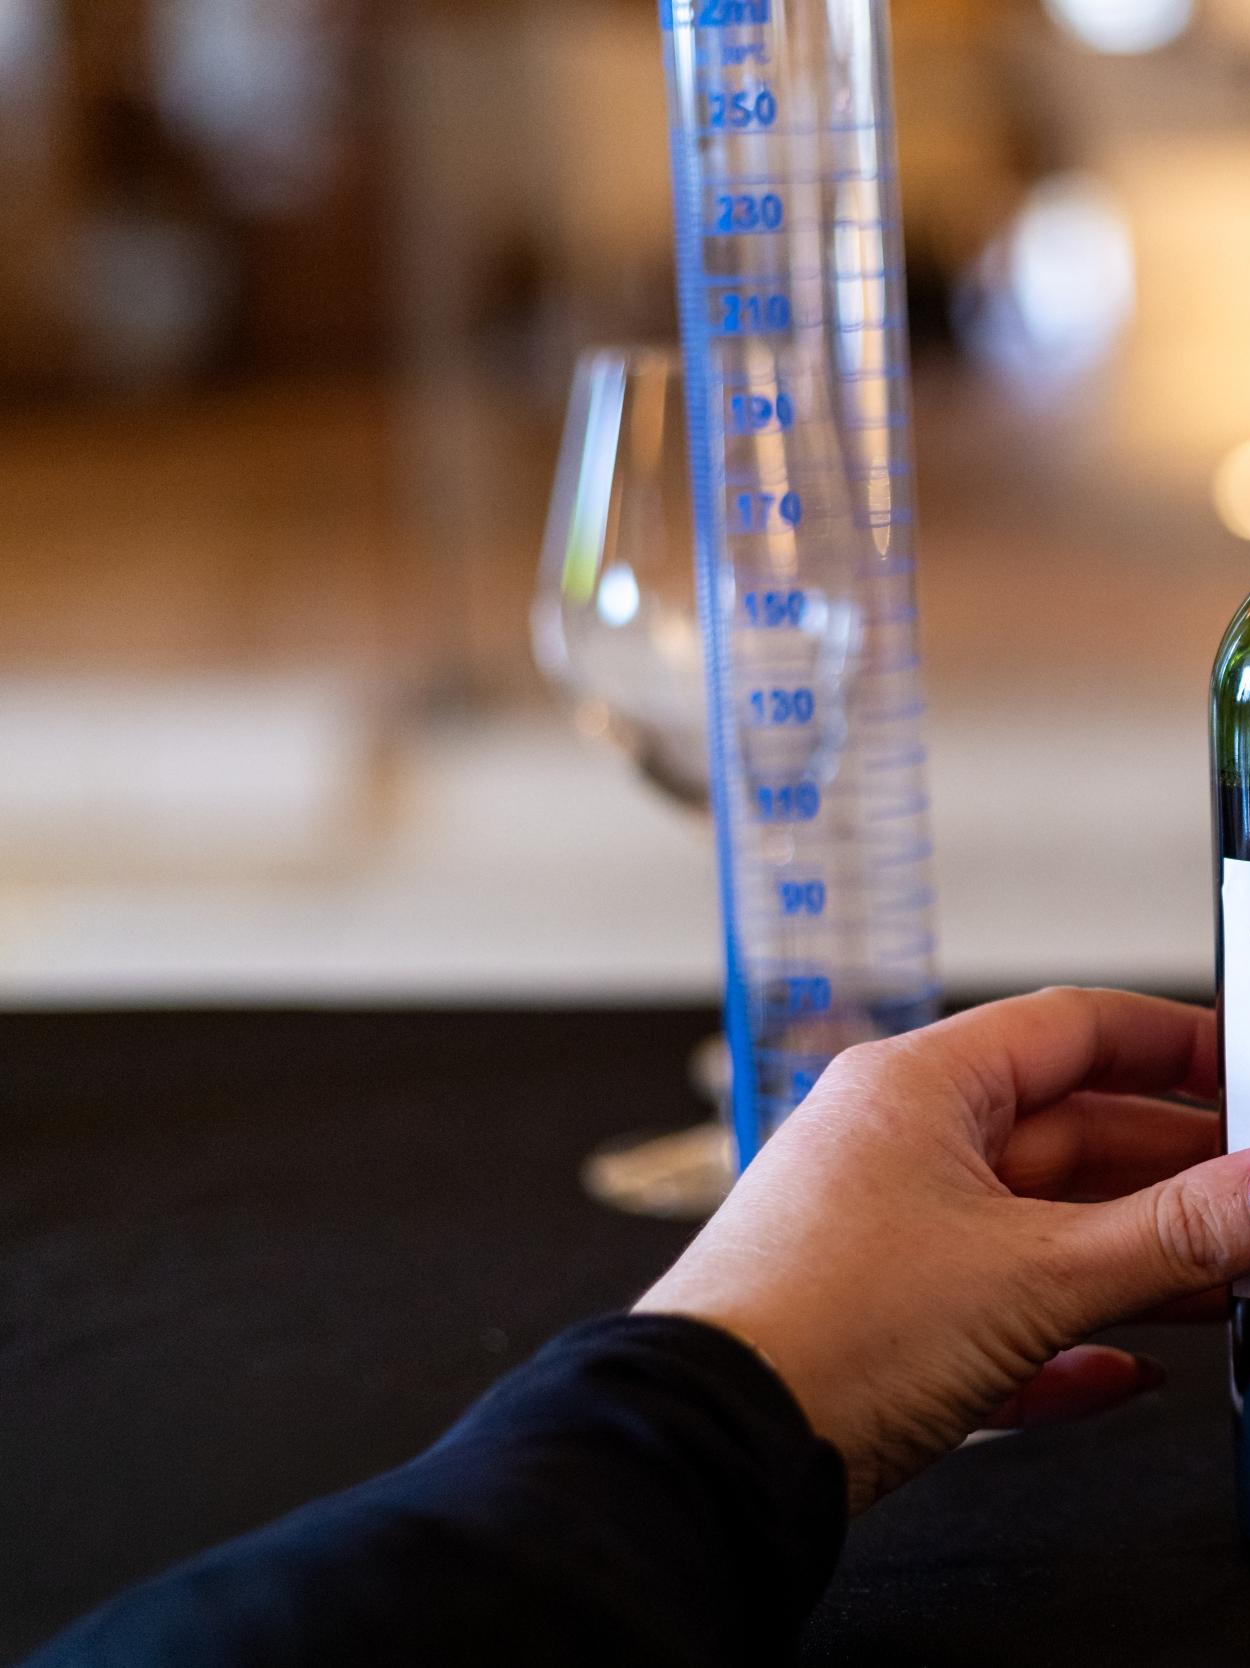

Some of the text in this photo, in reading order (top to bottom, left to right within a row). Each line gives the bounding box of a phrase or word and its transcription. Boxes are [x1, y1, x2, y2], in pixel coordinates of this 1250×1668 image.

[708, 90, 777, 128] 250
[716, 194, 783, 231] 230
[721, 294, 790, 331] 210
[731, 392, 795, 429] 190
[737, 491, 802, 528] 170
[744, 590, 805, 627] 150
[751, 688, 815, 725] 130
[757, 782, 820, 821] 110
[779, 881, 825, 915] 90
[786, 976, 831, 1014] 70
